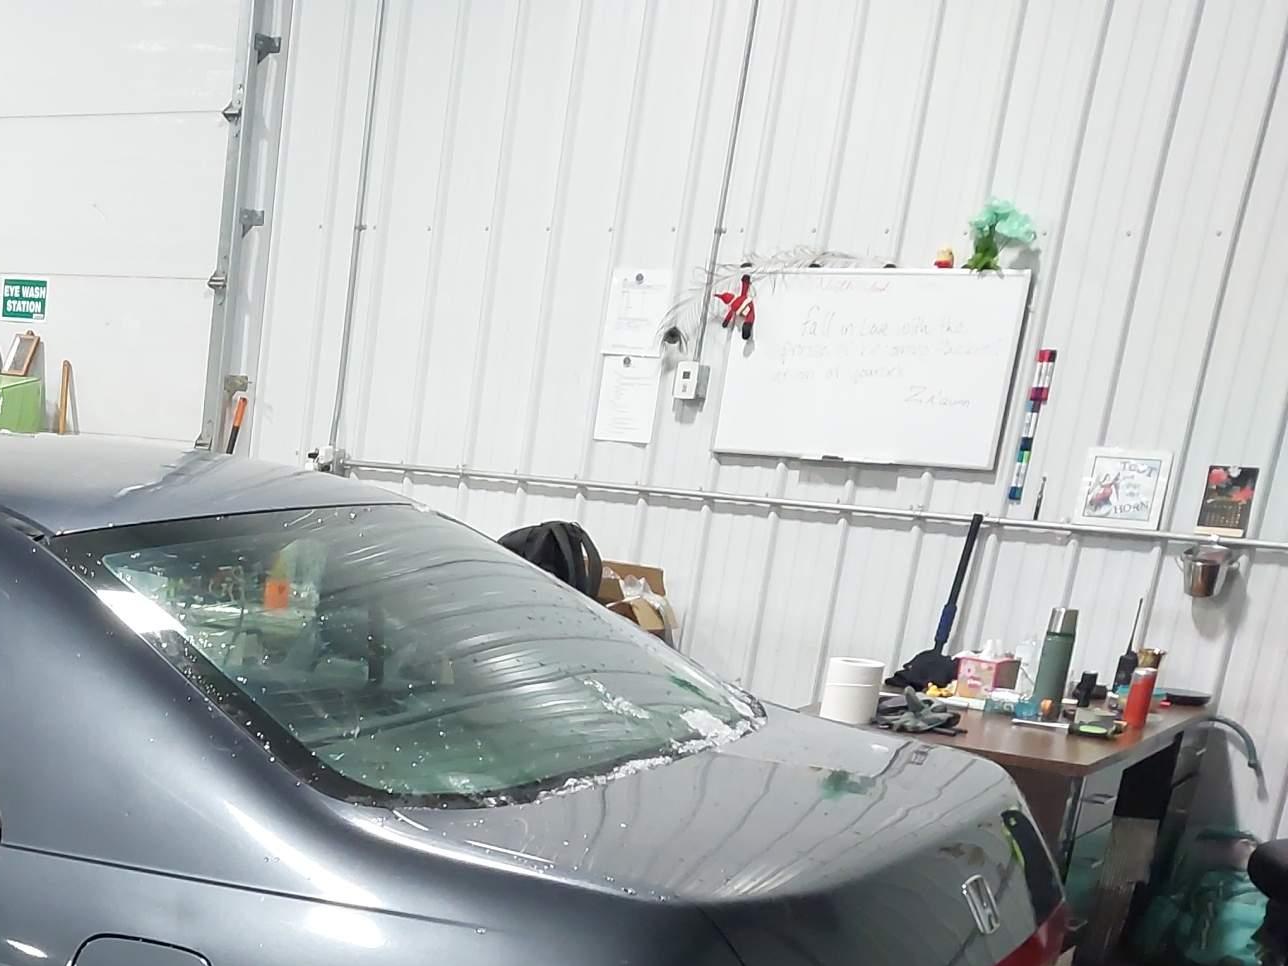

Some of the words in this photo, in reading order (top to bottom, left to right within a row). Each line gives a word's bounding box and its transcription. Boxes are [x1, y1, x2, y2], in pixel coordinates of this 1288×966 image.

[4, 285, 20, 297] EYE
[21, 285, 46, 299] WASH
[6, 299, 42, 312] STATION
[1113, 501, 1150, 514] HORN
